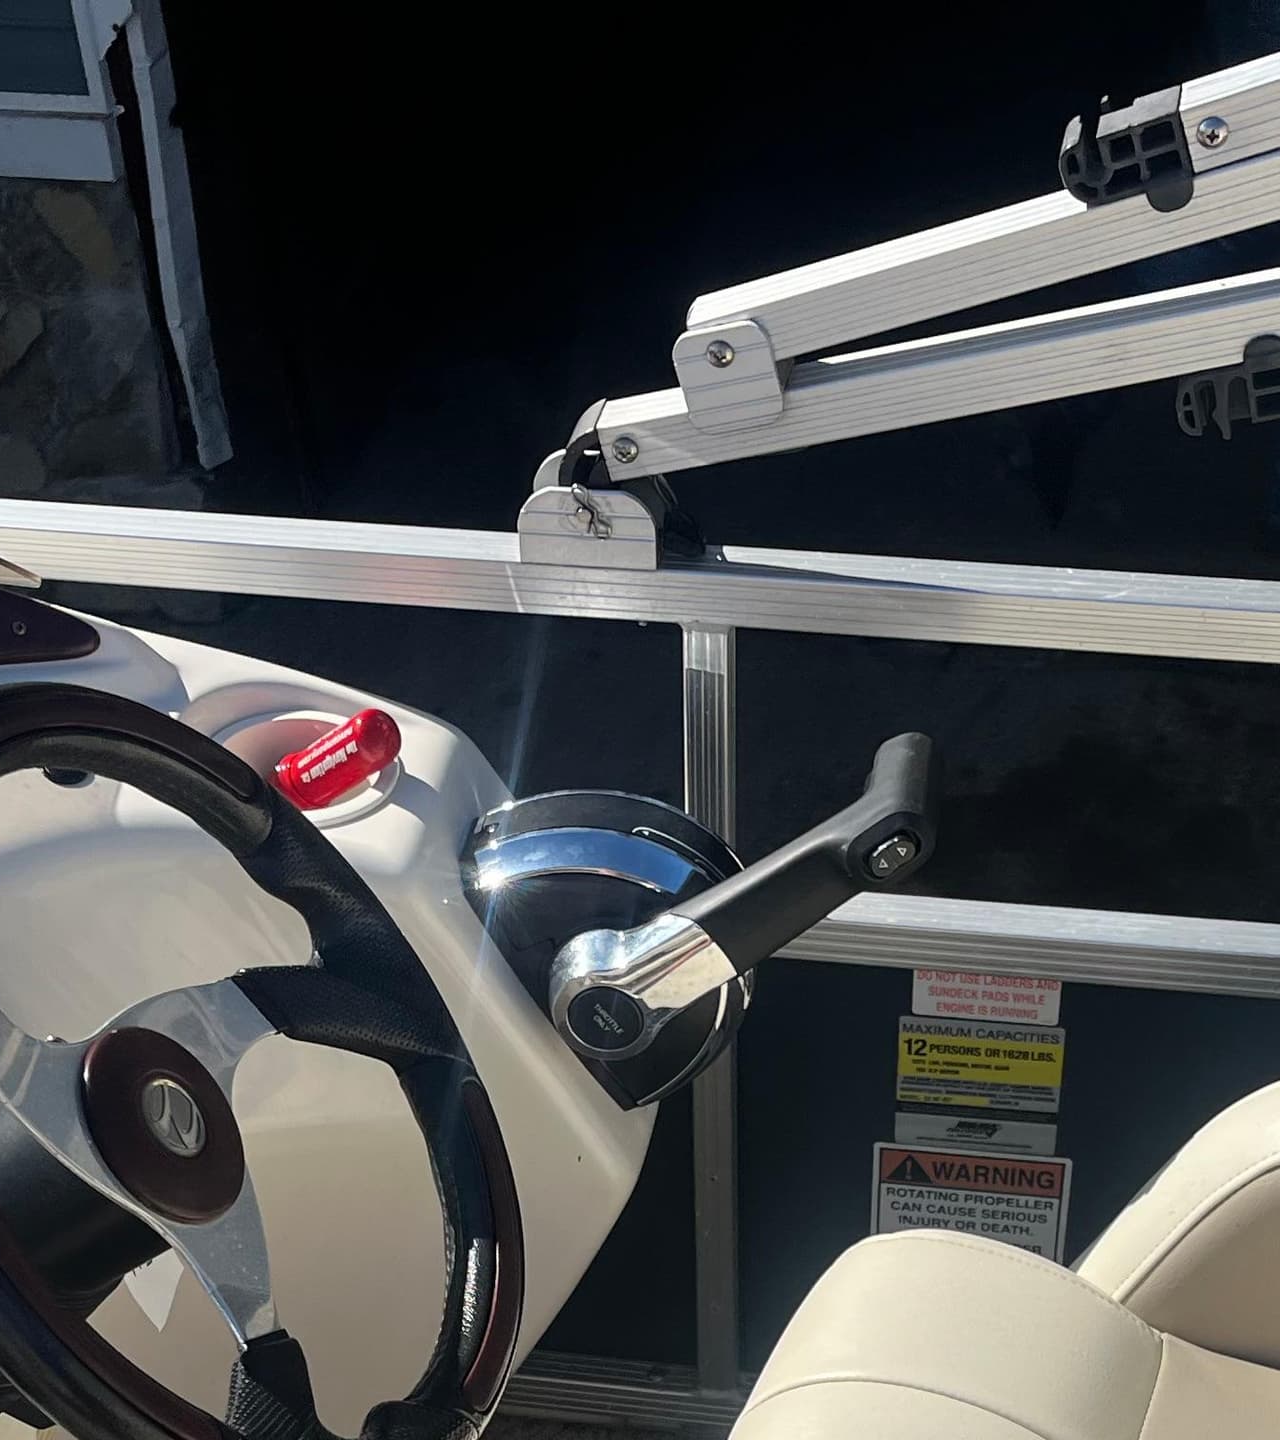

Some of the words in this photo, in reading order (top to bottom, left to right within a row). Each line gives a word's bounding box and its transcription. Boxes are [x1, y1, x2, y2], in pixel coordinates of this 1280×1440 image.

[936, 971, 958, 984] NOT
[928, 986, 978, 999] SUNDECK
[982, 990, 1010, 1002] PADS
[1012, 993, 1046, 1005] WHILE
[936, 1002, 976, 1015] ENGINE
[977, 1005, 989, 1016] IS
[990, 1006, 1039, 1020] RUNNING
[902, 1022, 971, 1038] MAXIMUM
[975, 1028, 1061, 1045] CAPACITIES
[903, 1037, 927, 1057] 12
[928, 1043, 982, 1058] PERSONS
[984, 1047, 1001, 1058] OR
[932, 1160, 1056, 1190] WARNING
[886, 1186, 960, 1203] ROTATING
[964, 1193, 1054, 1212] PROPELLER
[890, 1200, 922, 1213] CAN
[926, 1204, 977, 1218] CAUSE
[981, 1209, 1048, 1224] SERIOUS
[898, 1214, 951, 1229] INJURY
[955, 1220, 976, 1231] OR
[980, 1223, 1035, 1237] DEATH.
